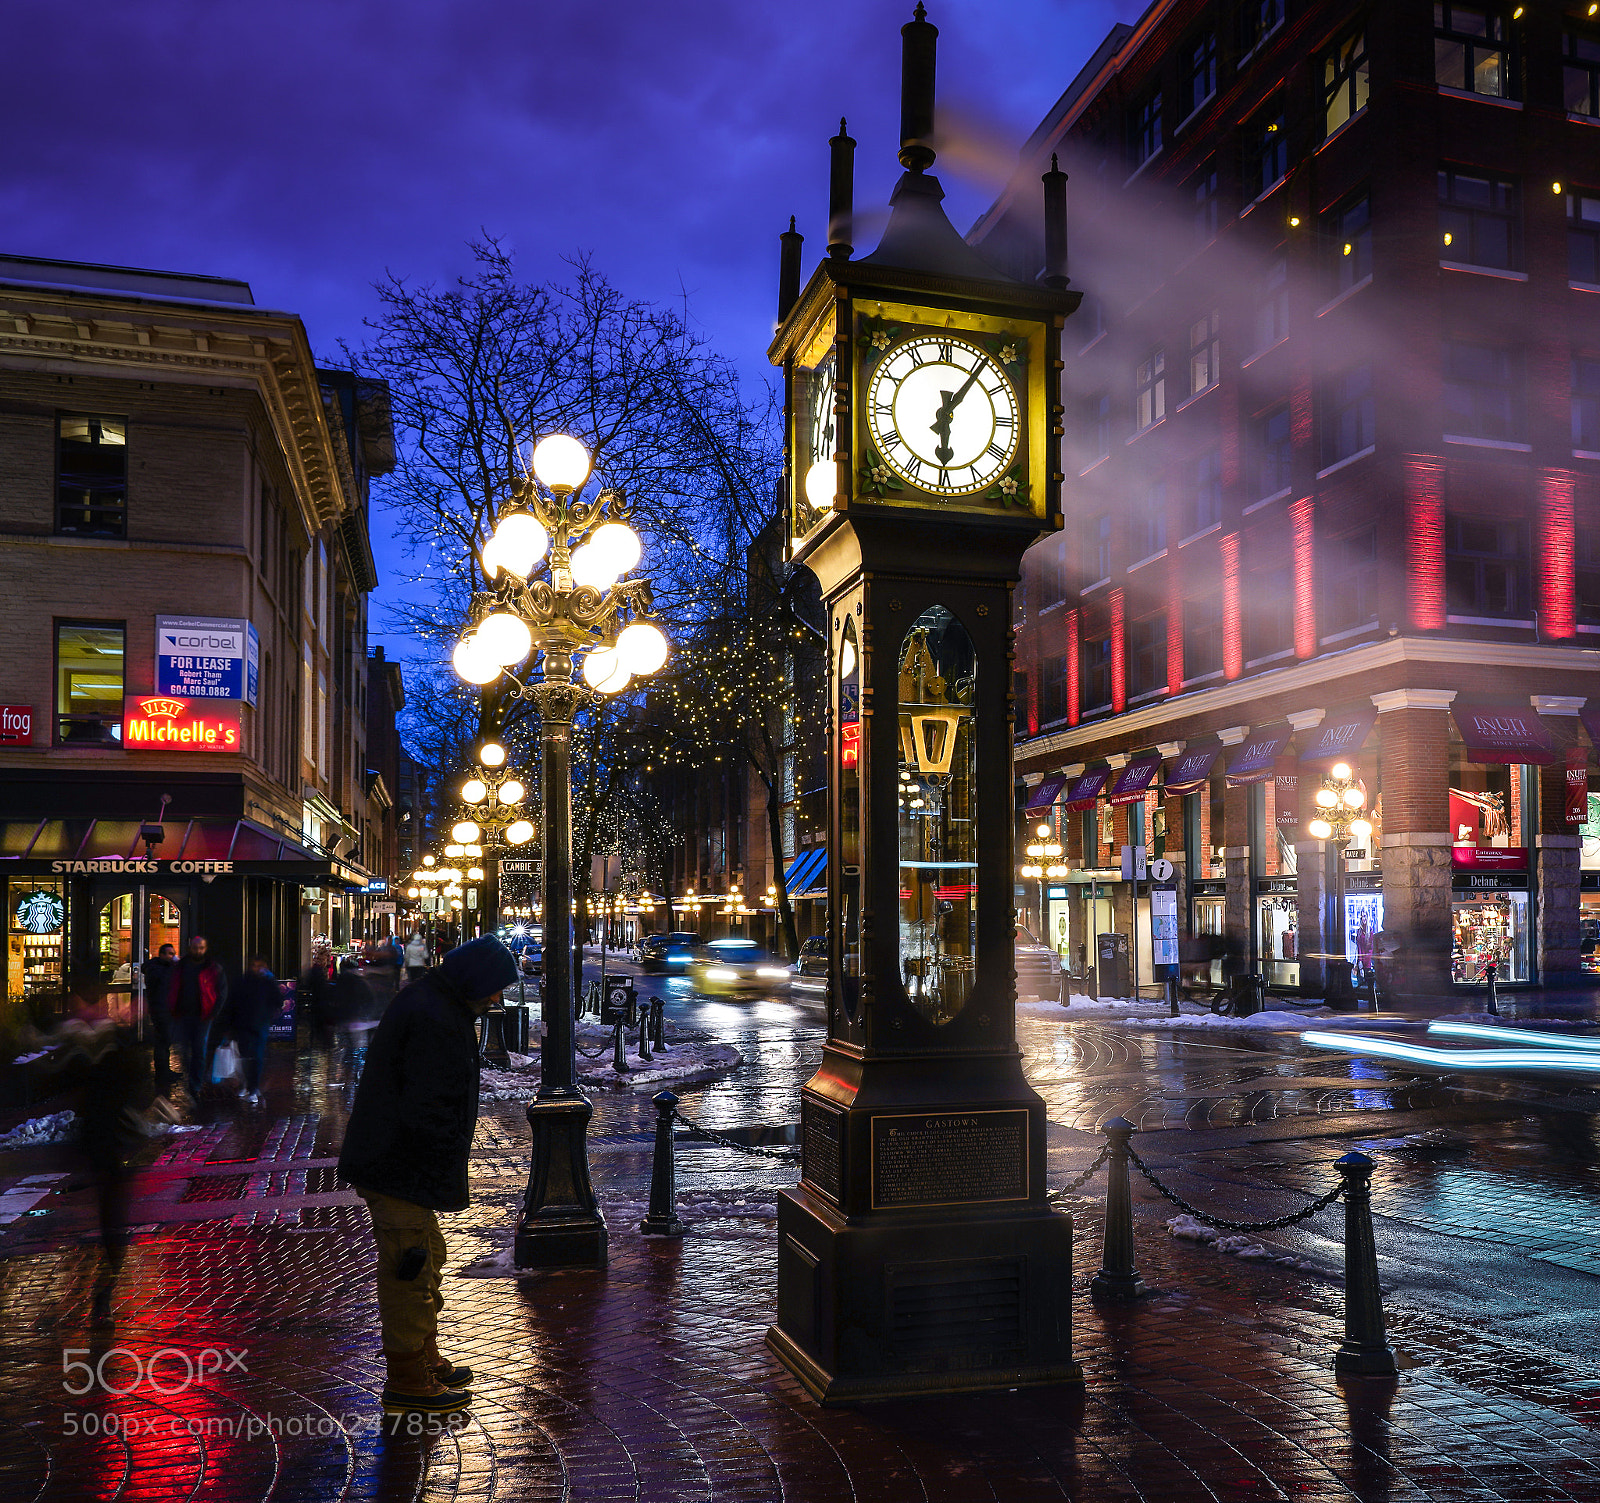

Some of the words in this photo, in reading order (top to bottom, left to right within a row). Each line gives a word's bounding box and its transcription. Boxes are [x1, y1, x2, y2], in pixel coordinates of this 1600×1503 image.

[178, 635, 236, 649] corbel
[170, 657, 193, 668] FOR
[197, 658, 231, 670] LEASE
[170, 685, 230, 696] 604.609.0882
[143, 702, 184, 715] VISIT
[2, 708, 30, 735] frog
[1474, 717, 1527, 731] INUIT
[1321, 723, 1360, 742] INUIT
[1245, 740, 1279, 757] INUIT
[1126, 765, 1151, 779] INUIT
[1567, 769, 1586, 778] INUIT
[52, 860, 158, 873] STARBUCKS
[170, 861, 233, 873] COFFEE
[506, 862, 531, 872] CAMBIE
[1471, 876, 1498, 886] Delané
[926, 1118, 978, 1128] GASTOWN
